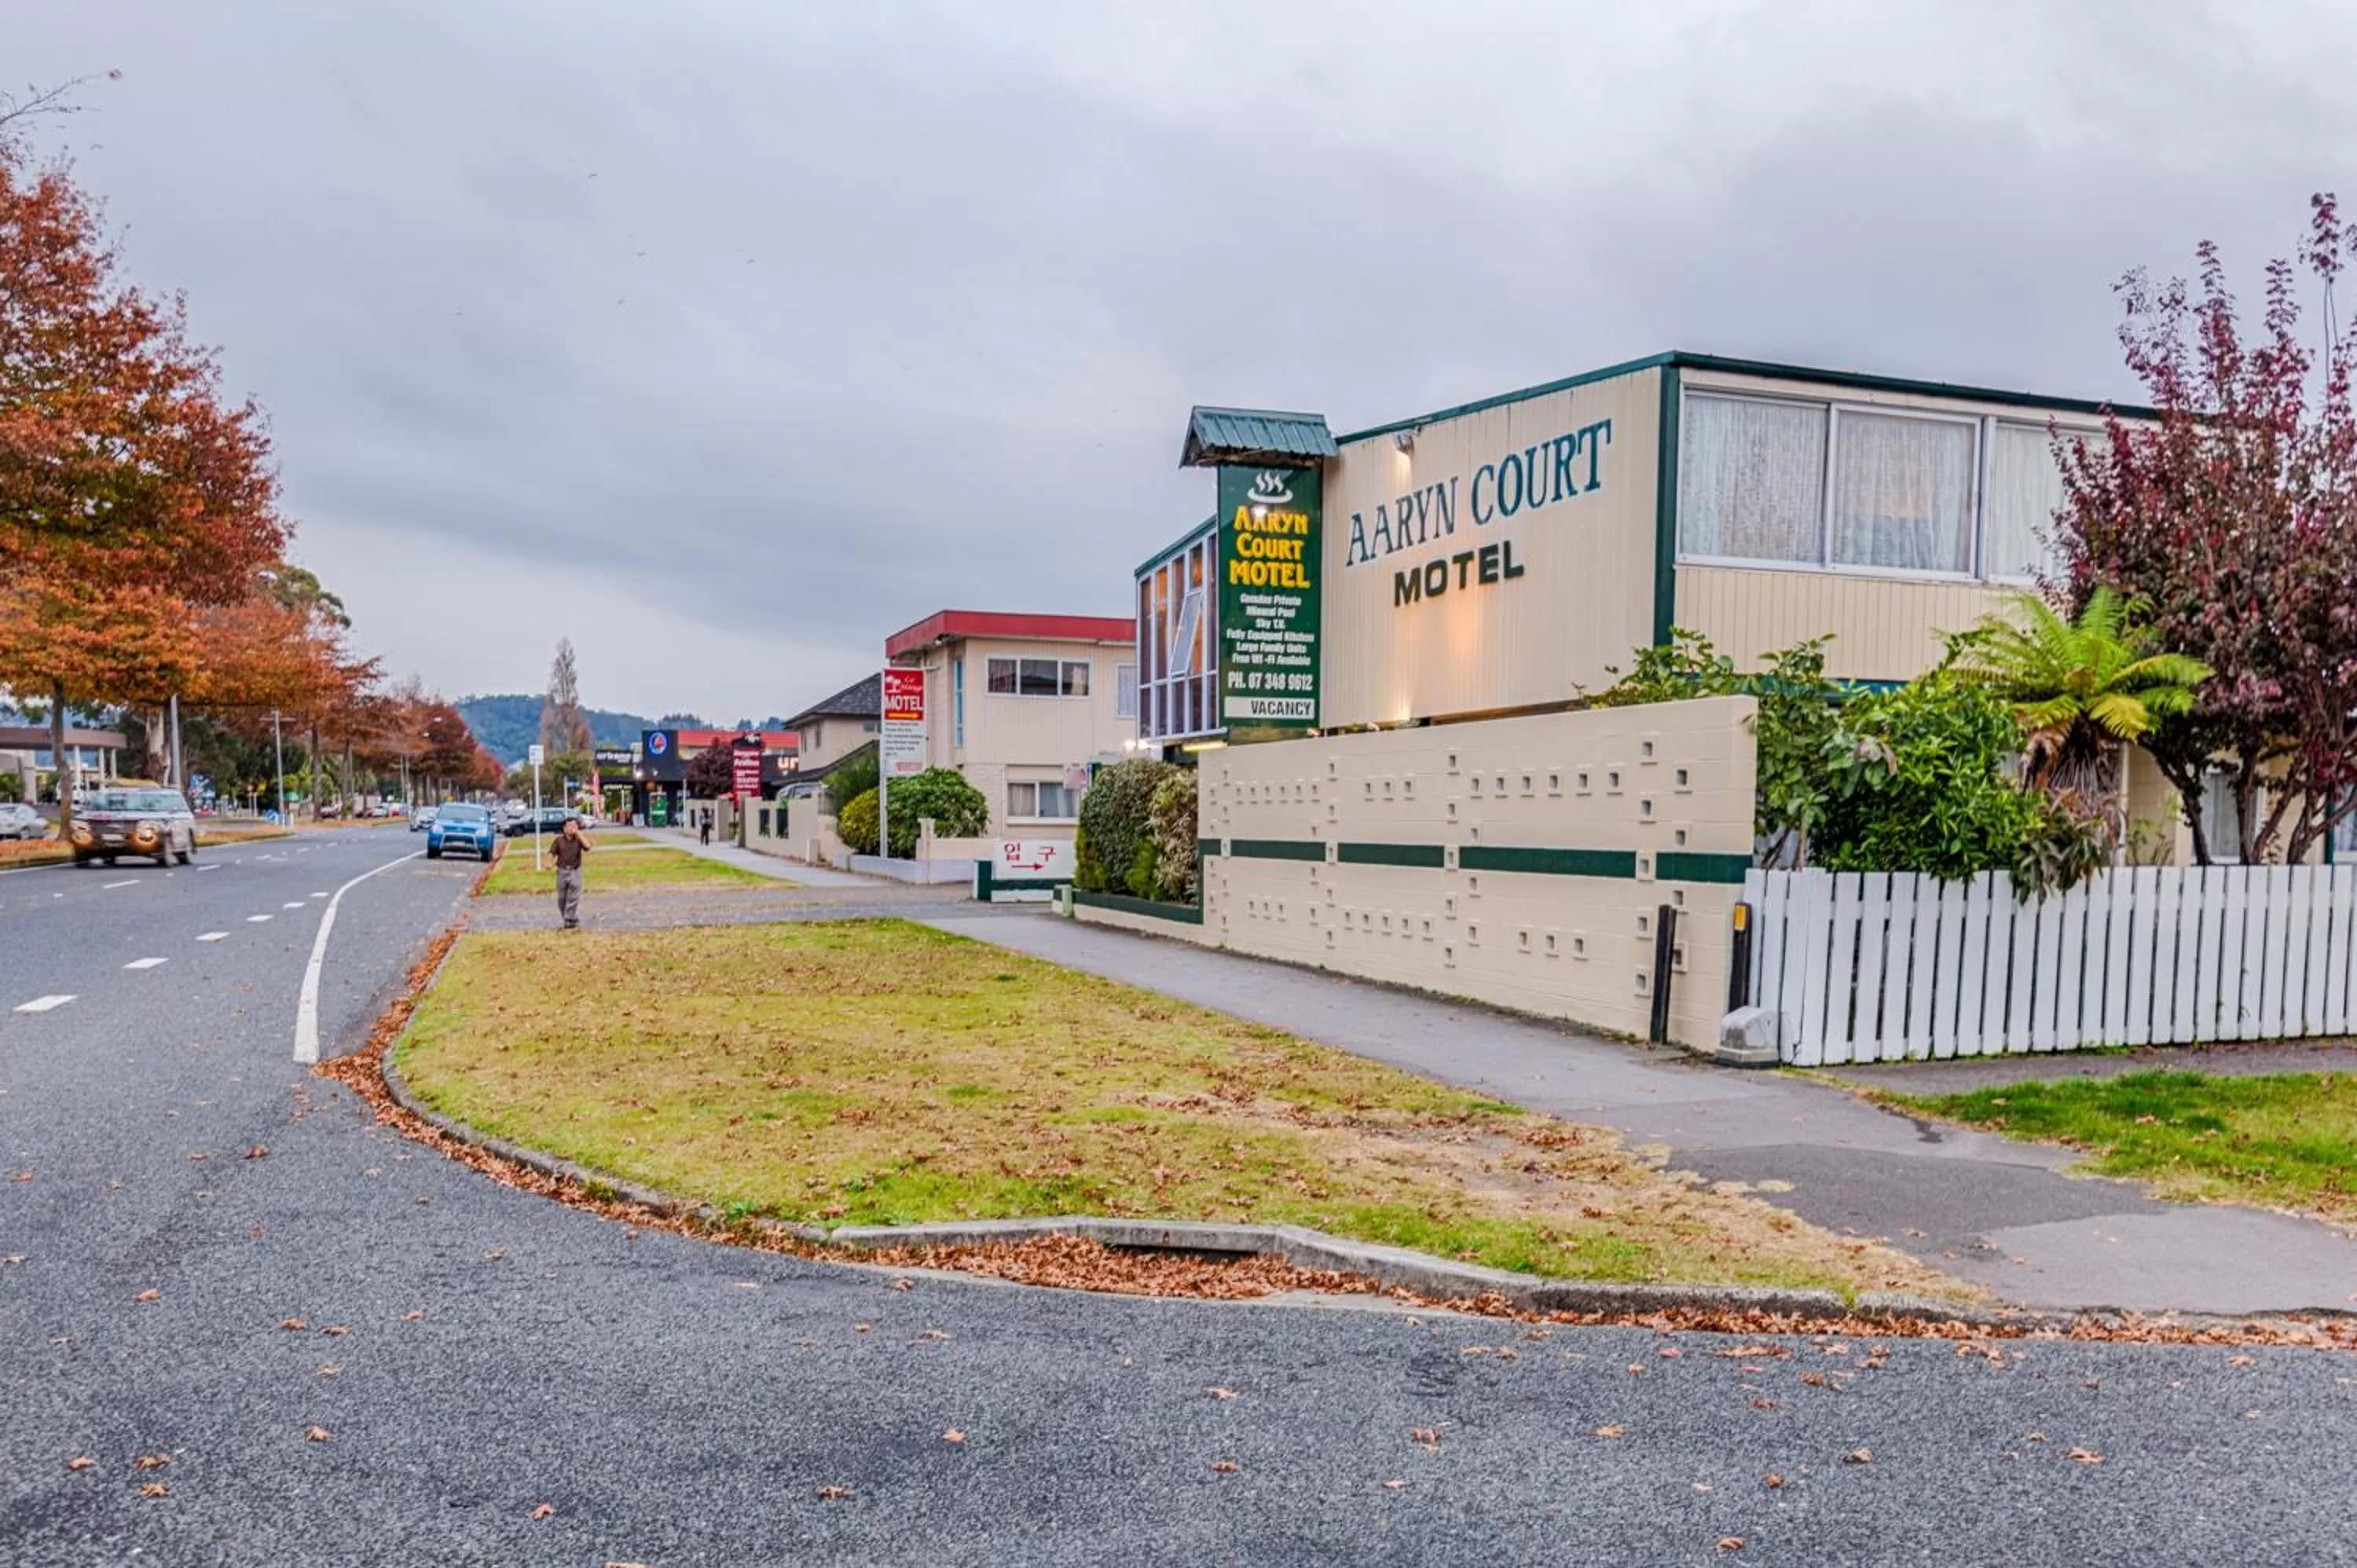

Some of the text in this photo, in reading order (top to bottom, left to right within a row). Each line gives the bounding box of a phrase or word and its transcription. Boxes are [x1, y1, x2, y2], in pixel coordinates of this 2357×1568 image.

[1346, 419, 1613, 566] AARYN COURT
[1233, 505, 1309, 535] AARYN
[1236, 532, 1305, 560] COURT
[1229, 559, 1311, 588] MOTEL
[1395, 540, 1526, 606] MOTEL
[1274, 595, 1302, 606] Private
[1246, 605, 1296, 617] Mineral Pool
[1255, 617, 1271, 628] Sky
[1226, 628, 1246, 639] Fully
[1247, 629, 1283, 641] Equipped
[1236, 641, 1307, 653] Large Family Units
[1232, 653, 1250, 663] Free
[1277, 654, 1311, 665] Available
[1248, 672, 1263, 689] 07
[1264, 672, 1286, 690] 348
[884, 694, 924, 711] MOTEL
[1250, 700, 1312, 716] VACANCY
